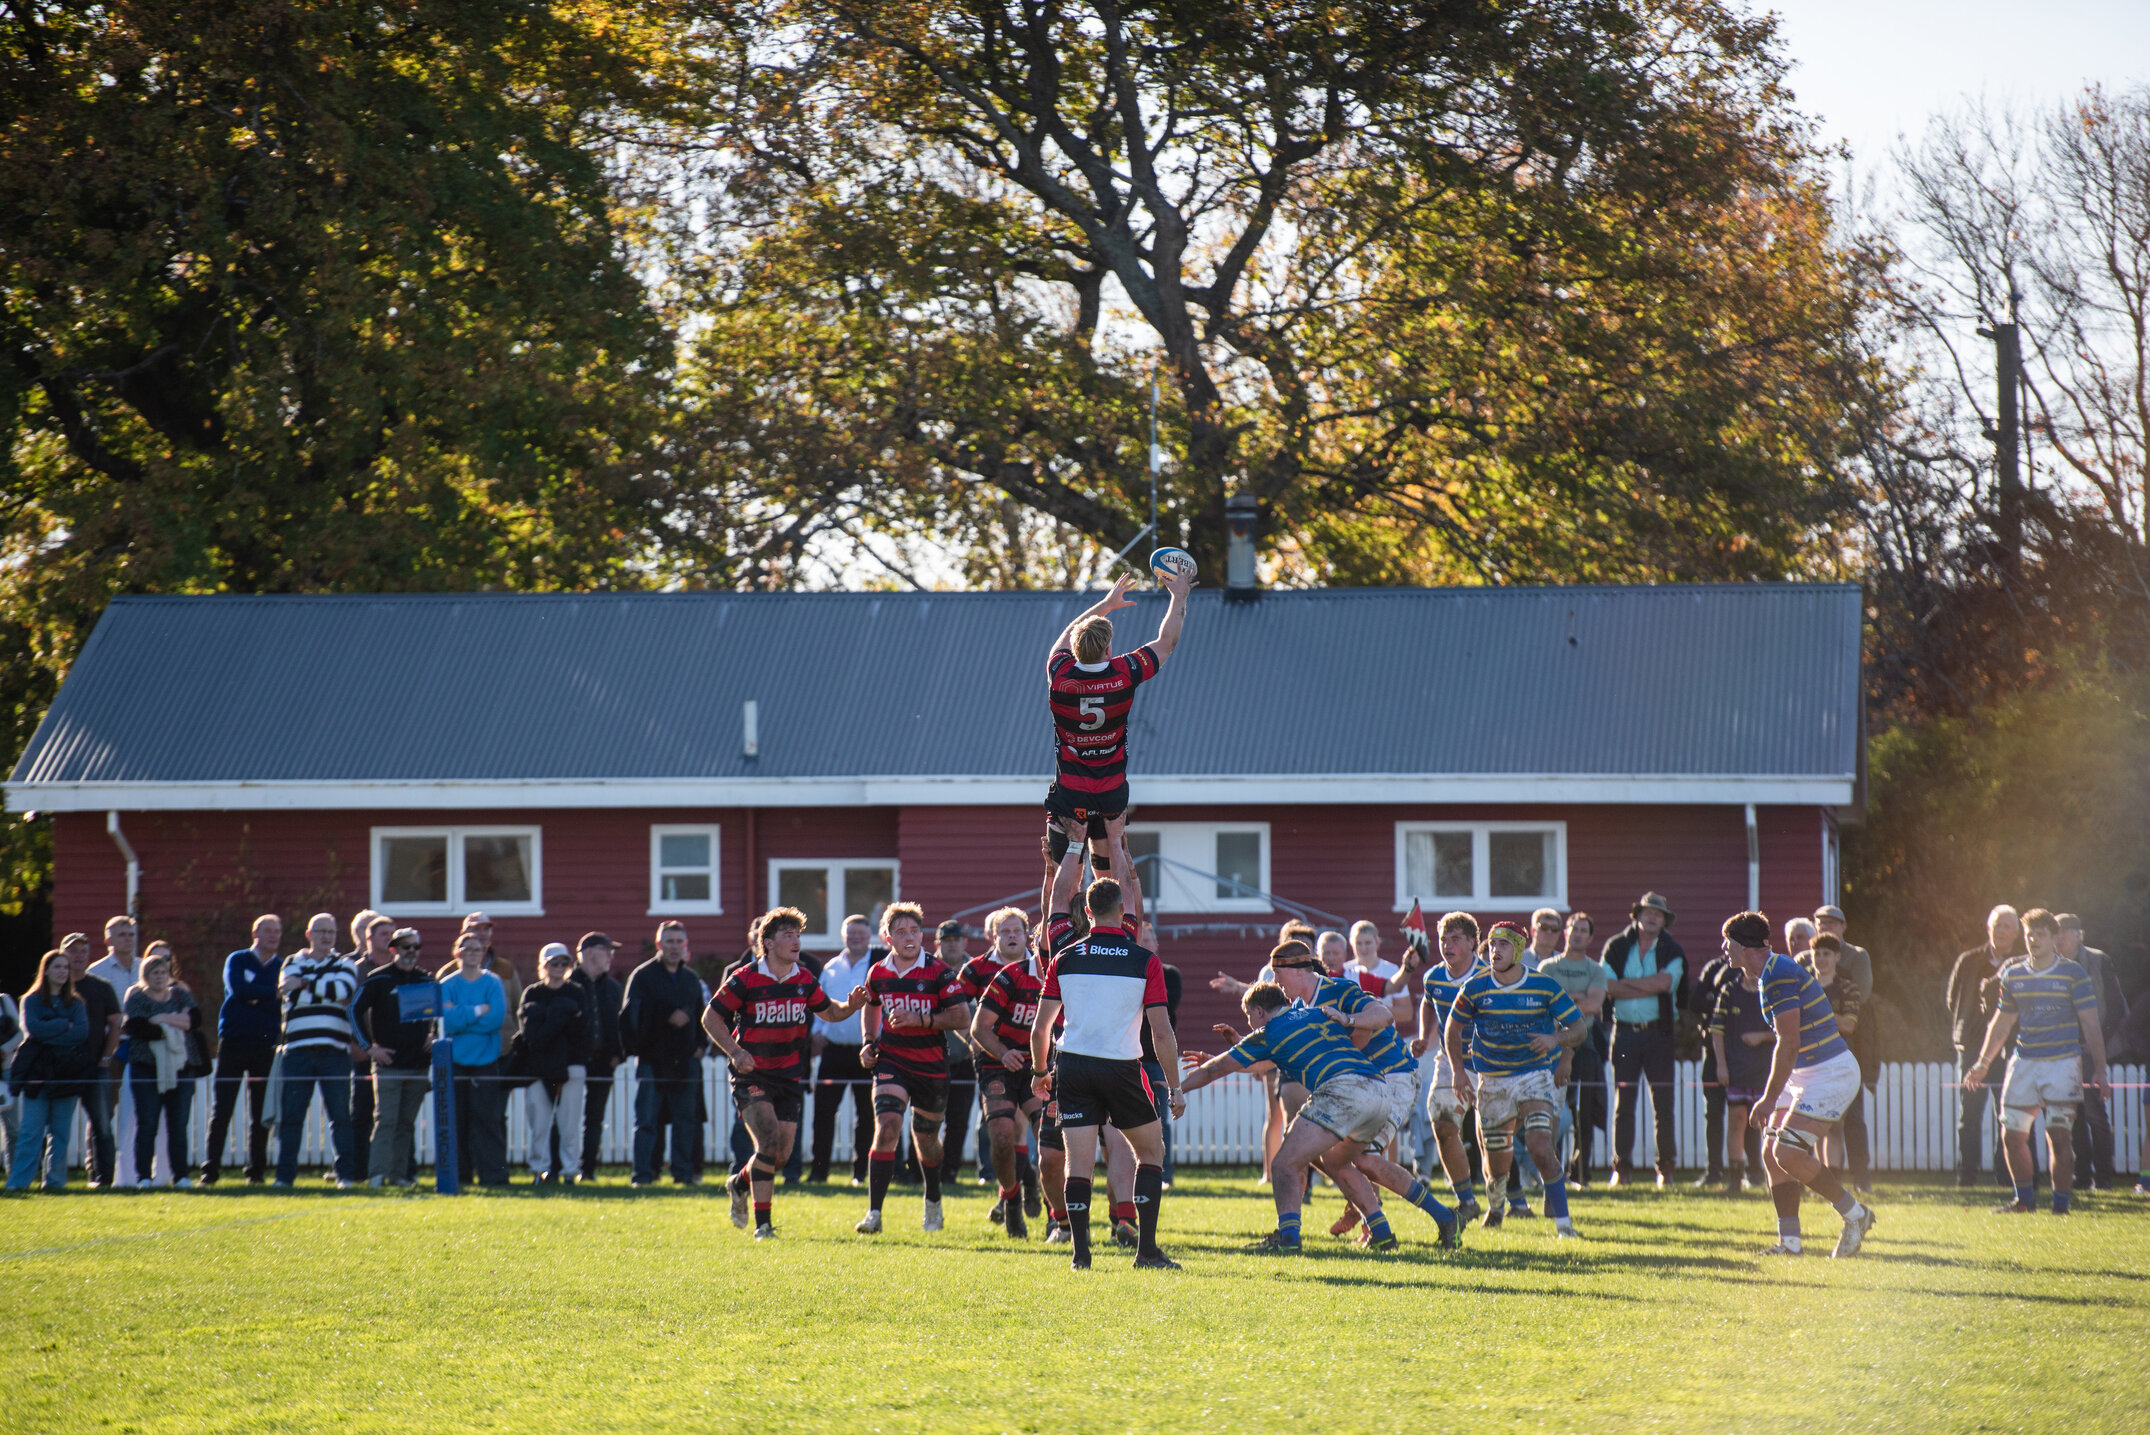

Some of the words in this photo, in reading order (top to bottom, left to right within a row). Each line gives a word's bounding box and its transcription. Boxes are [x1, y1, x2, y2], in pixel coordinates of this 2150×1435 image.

[1086, 680, 1124, 690] VIRTUE
[1078, 696, 1106, 731] 5
[1077, 732, 1117, 743] DEVCORP
[1089, 944, 1129, 956] Blacks
[1063, 1112, 1083, 1120] Blacks
